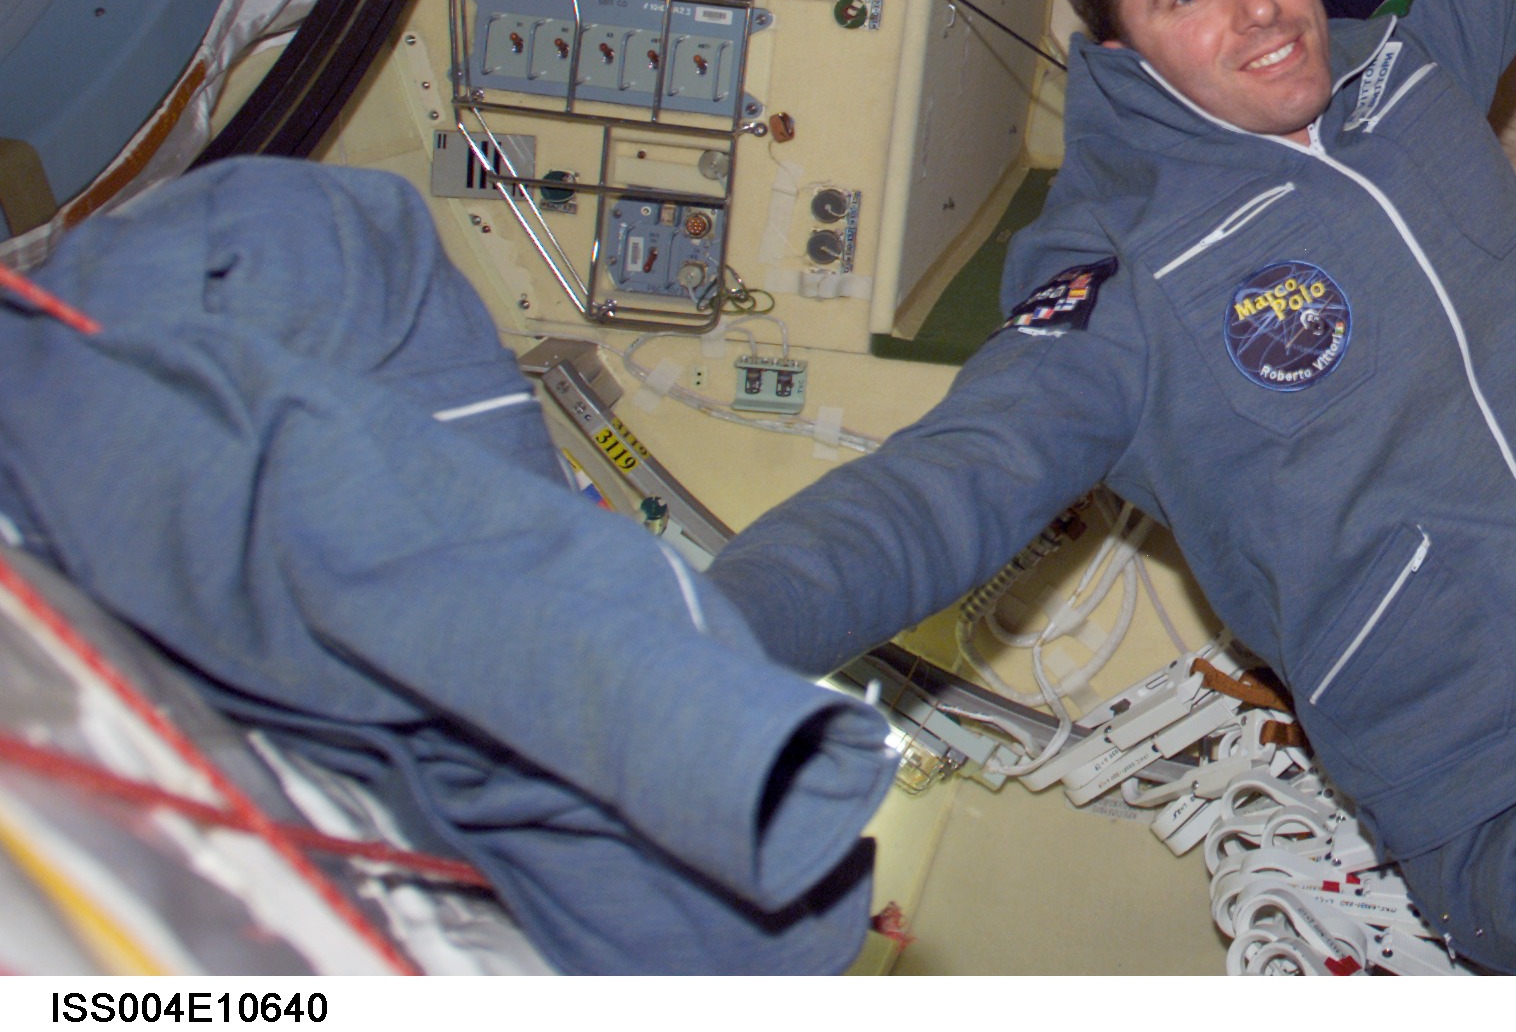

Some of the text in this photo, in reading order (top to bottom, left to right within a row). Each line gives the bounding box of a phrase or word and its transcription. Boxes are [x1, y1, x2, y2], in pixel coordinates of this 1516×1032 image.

[1234, 277, 1297, 321] Marco
[1271, 280, 1326, 322] Polo
[1259, 332, 1343, 382] Roberto Vittori
[595, 429, 637, 470] 3119
